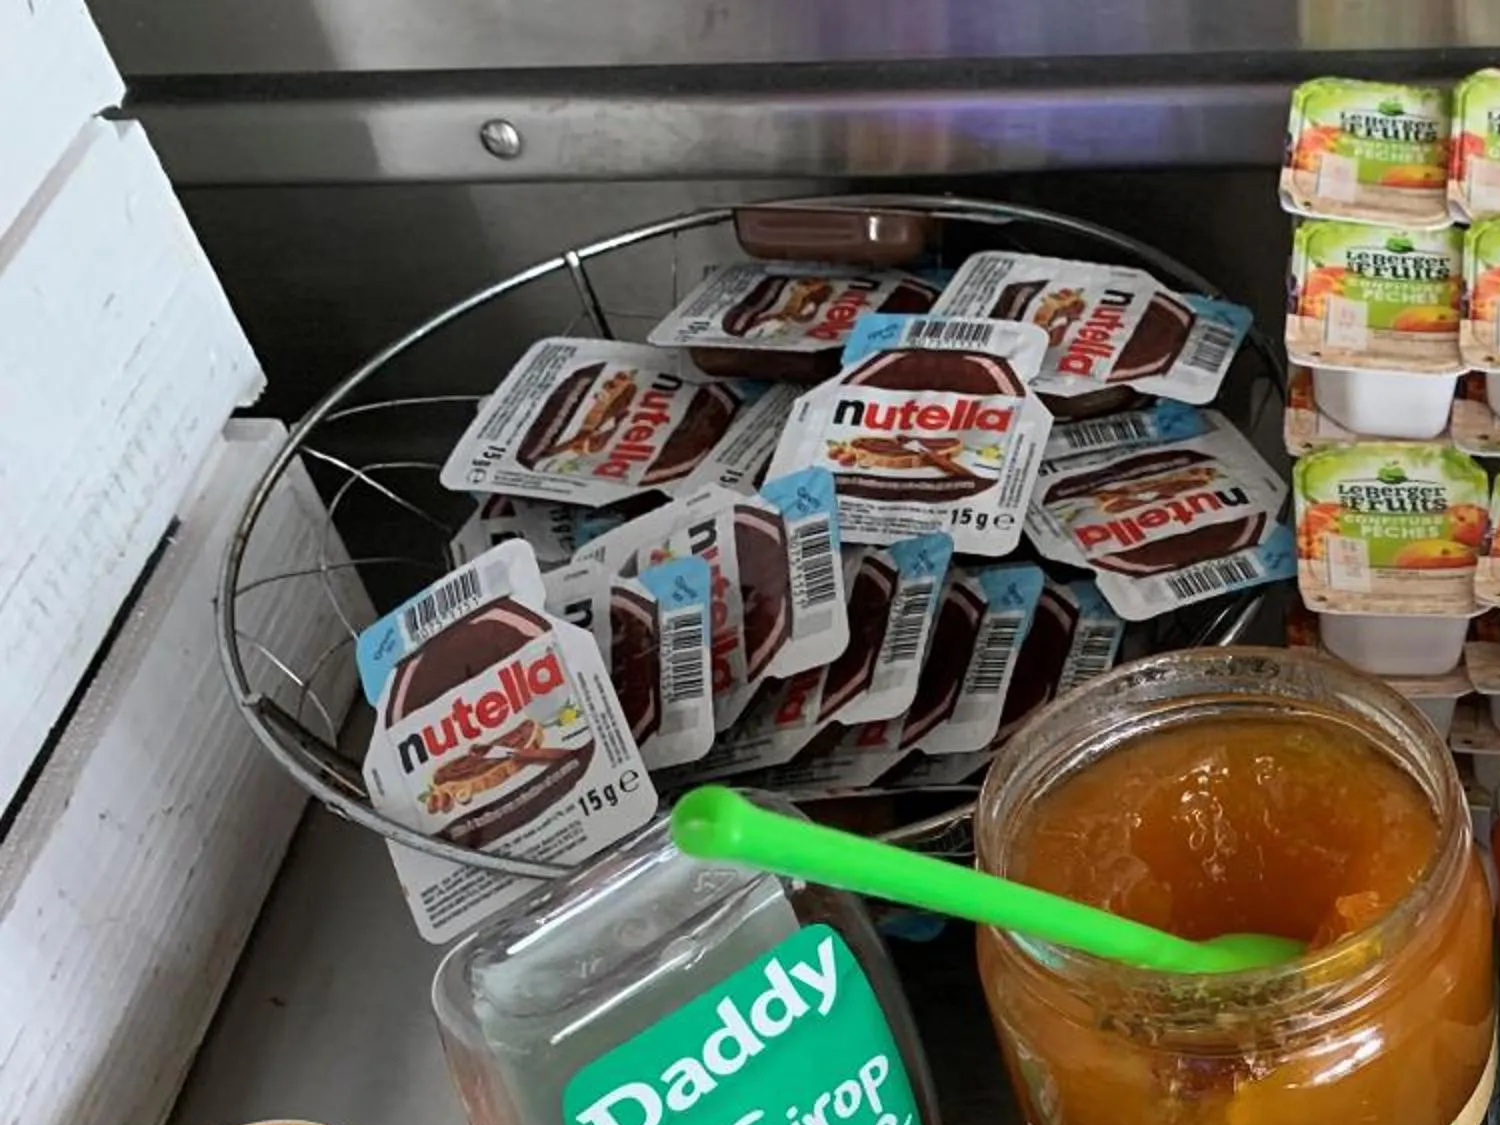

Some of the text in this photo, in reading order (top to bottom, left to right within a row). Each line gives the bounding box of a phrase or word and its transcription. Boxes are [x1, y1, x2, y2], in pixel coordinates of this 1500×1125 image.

[1057, 289, 1136, 376] nutella
[592, 372, 684, 481] nutella
[833, 399, 1013, 433] nutella
[950, 508, 972, 526] 15
[976, 512, 988, 531] g
[1075, 486, 1251, 551] nutella
[1350, 495, 1448, 513] Fruits
[396, 648, 565, 775] nutella
[576, 784, 620, 818] 15 g
